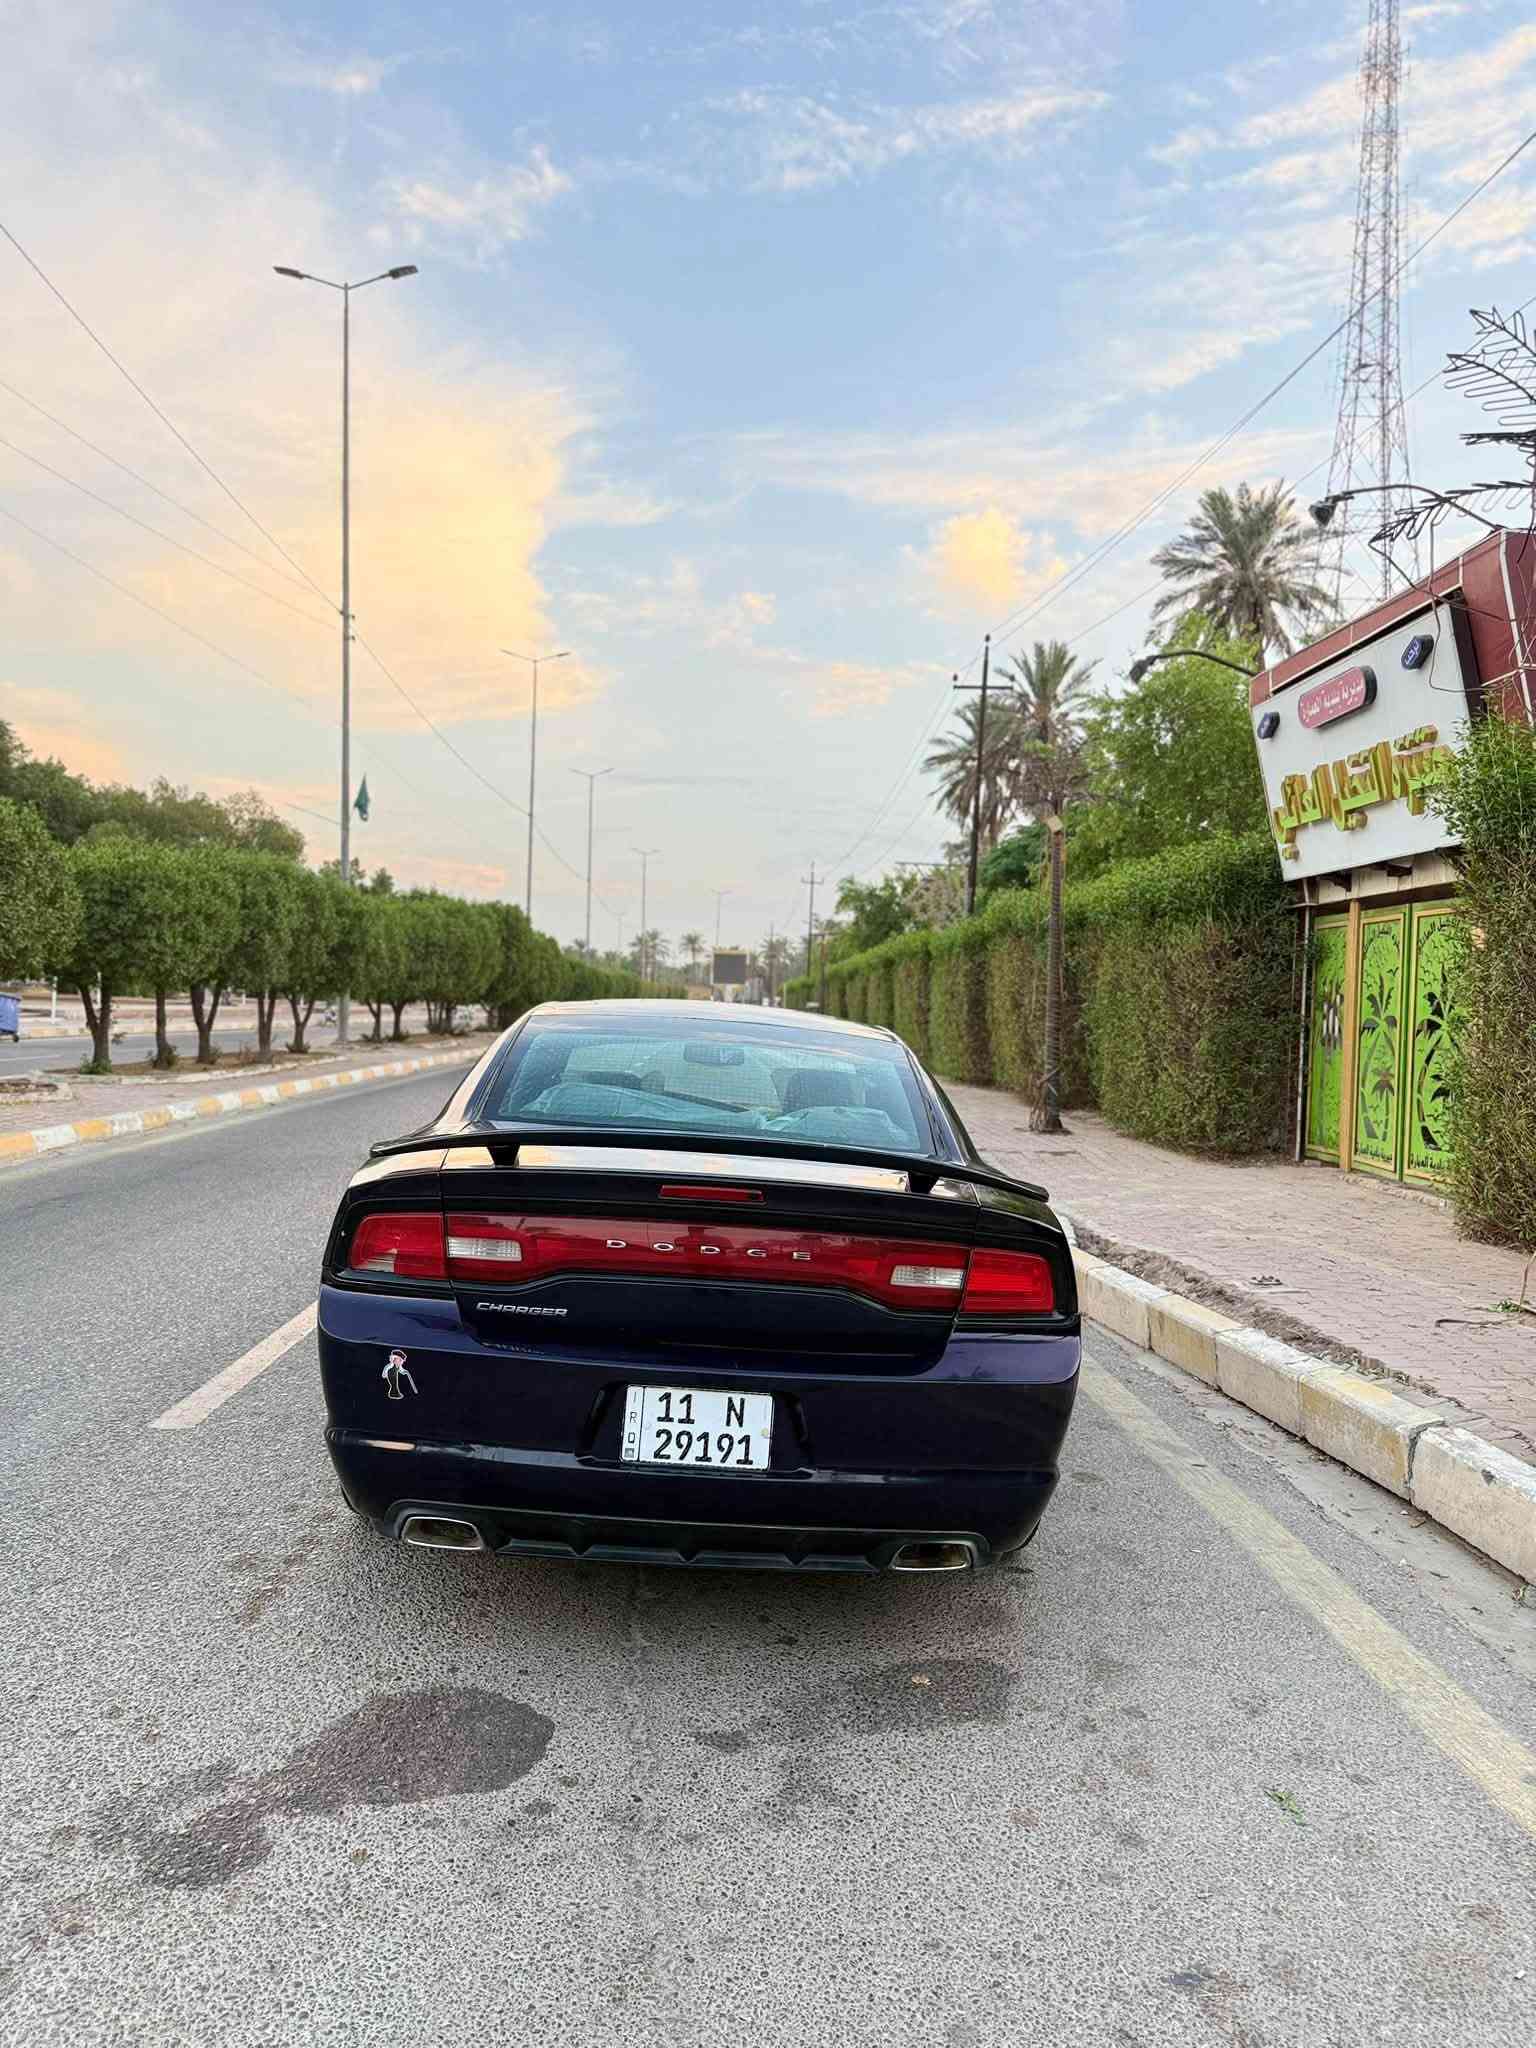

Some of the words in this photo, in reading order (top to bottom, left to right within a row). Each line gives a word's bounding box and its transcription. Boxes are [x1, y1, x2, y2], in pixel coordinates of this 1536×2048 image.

[606, 1239, 812, 1261] DODGE
[476, 1302, 569, 1317] CHARGER
[657, 1392, 696, 1425] 11
[725, 1396, 746, 1428] N
[653, 1428, 754, 1466] 29191
